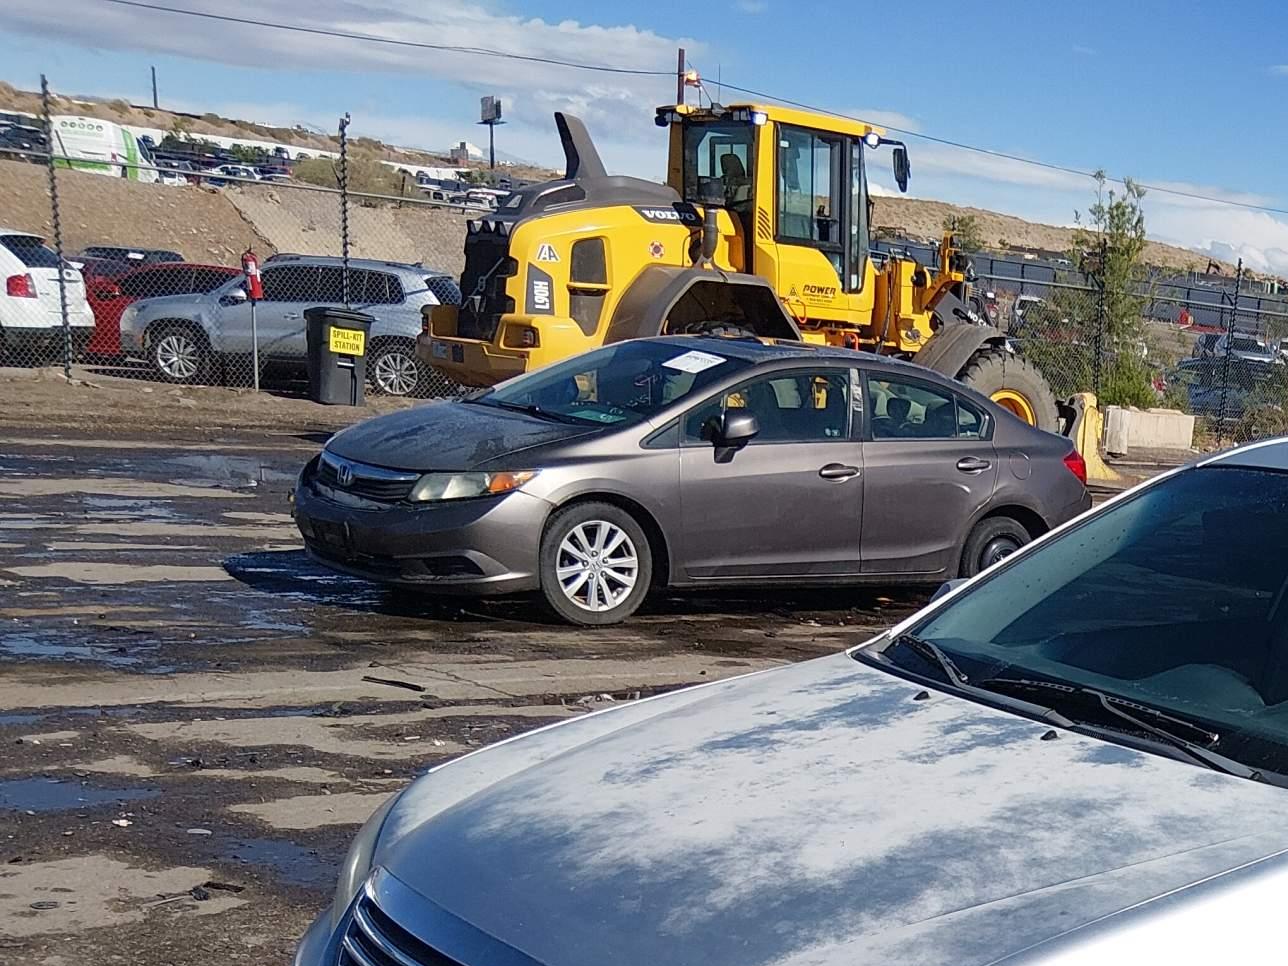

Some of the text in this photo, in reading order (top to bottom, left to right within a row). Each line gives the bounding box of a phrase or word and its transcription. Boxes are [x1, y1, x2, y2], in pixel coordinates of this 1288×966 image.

[641, 209, 697, 221] VOLVO
[533, 280, 550, 310] L90H
[802, 284, 837, 296] POWER
[332, 329, 363, 342] SPILL-KIT
[334, 340, 360, 352] STATION
